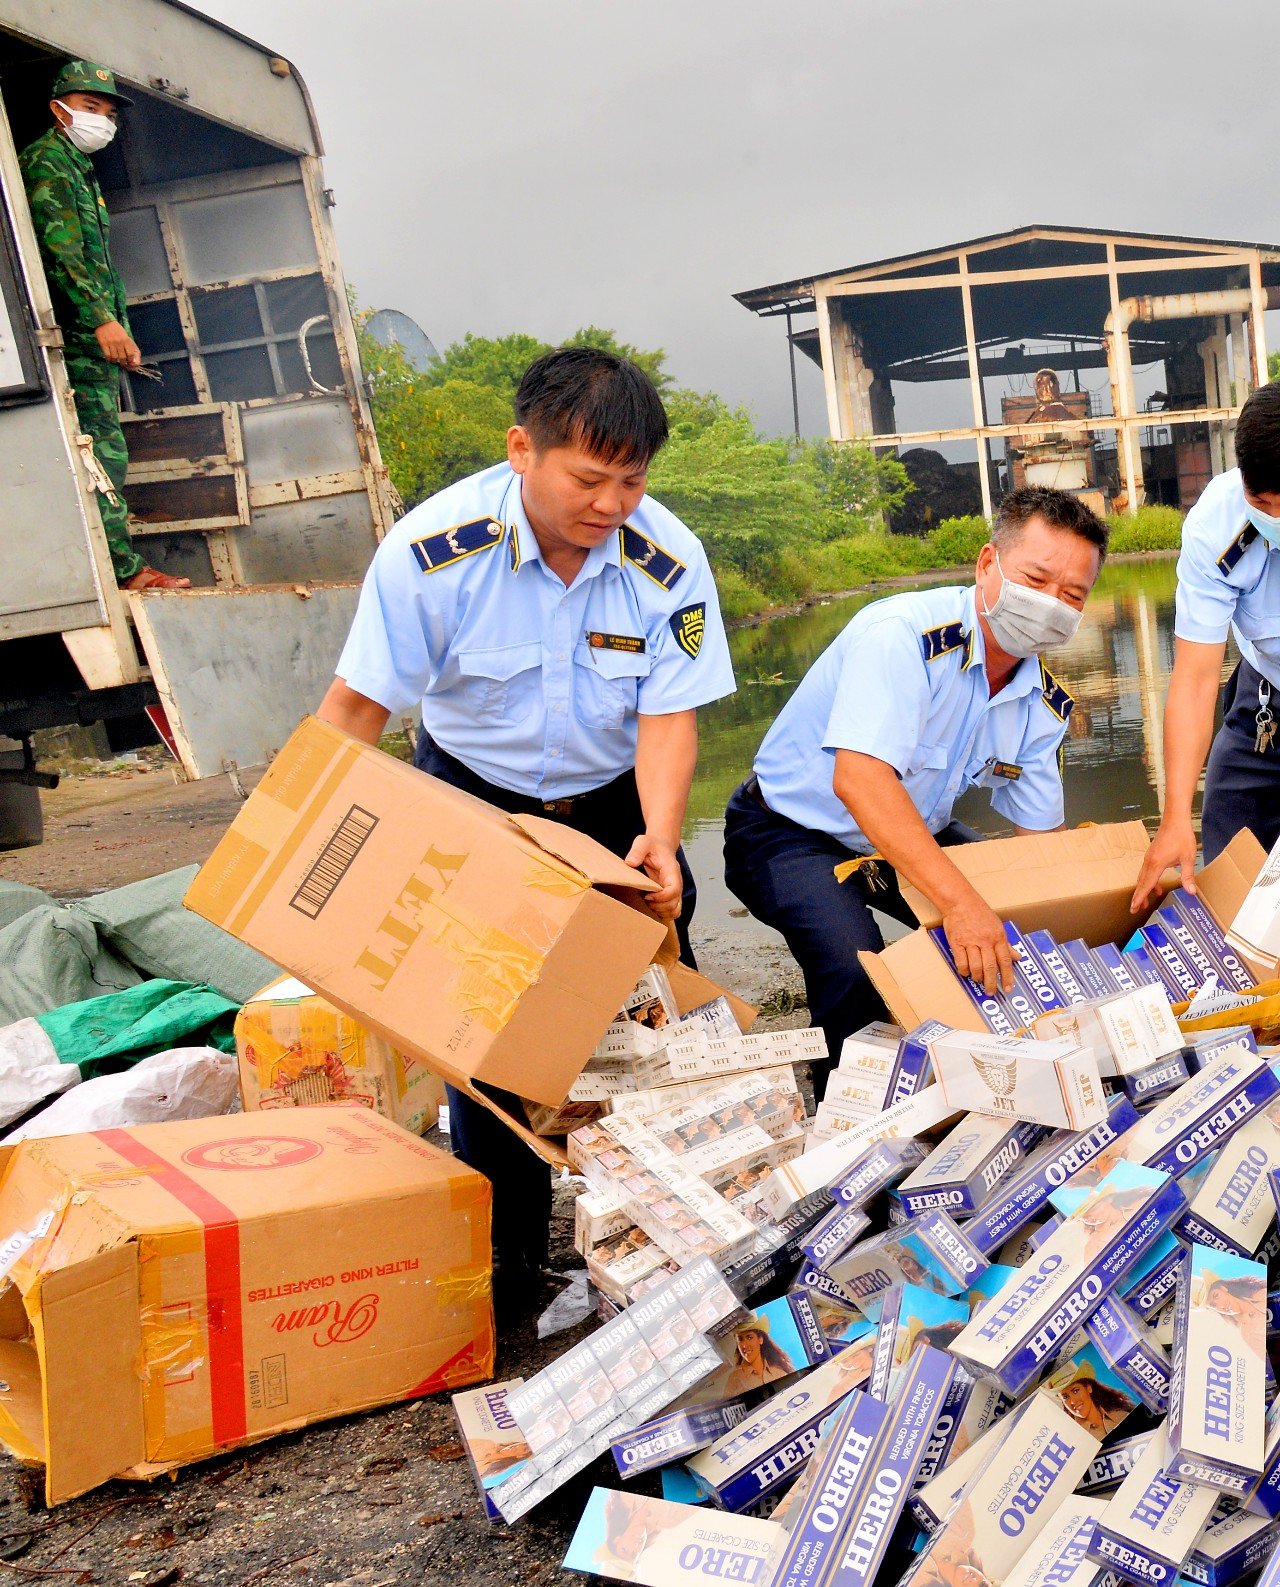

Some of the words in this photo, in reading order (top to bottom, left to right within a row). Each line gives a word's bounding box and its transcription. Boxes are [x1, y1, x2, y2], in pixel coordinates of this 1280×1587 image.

[682, 609, 702, 624] DMS
[353, 844, 470, 991] YETT
[676, 1046, 694, 1054] YETT
[708, 1041, 726, 1050] YETT
[741, 1037, 758, 1045] YETT
[712, 1057, 730, 1066] YETT
[857, 1055, 890, 1072] JET
[841, 1086, 874, 1102] JET
[994, 1097, 1015, 1111] JET
[1080, 1074, 1094, 1106] JET
[1175, 1090, 1256, 1162] HERO
[981, 1137, 1021, 1192] HERO
[1215, 1145, 1268, 1220] HERO
[907, 1190, 964, 1211] HERO
[767, 1209, 806, 1245] BASTOS
[929, 1219, 977, 1274] HERO
[340, 1265, 372, 1284] KING
[375, 1257, 419, 1279] FILTER
[674, 1259, 716, 1296] BASTOS
[247, 1273, 335, 1302] CIGARETTES
[976, 1254, 1062, 1342] HERO
[271, 1292, 379, 1348] Ram
[635, 1288, 677, 1328] BASTOS
[595, 1320, 636, 1356] BASTOS
[672, 1344, 699, 1366] BASTOS
[551, 1349, 597, 1388] BASTOS
[631, 1374, 659, 1398] BASTOS
[509, 1374, 551, 1418] BASTOS
[1203, 1345, 1233, 1442] HERO
[889, 1427, 908, 1461] BLENDED
[903, 1404, 917, 1427] WITH
[911, 1381, 927, 1408] FINEST
[901, 1428, 919, 1462] VIRGINIA
[915, 1388, 935, 1429] TOBACCOS
[622, 1429, 687, 1465] HERO
[812, 1426, 873, 1533] HERO
[999, 1431, 1076, 1538] HERO
[1178, 1462, 1248, 1491] HERO
[841, 1468, 902, 1577] HERO
